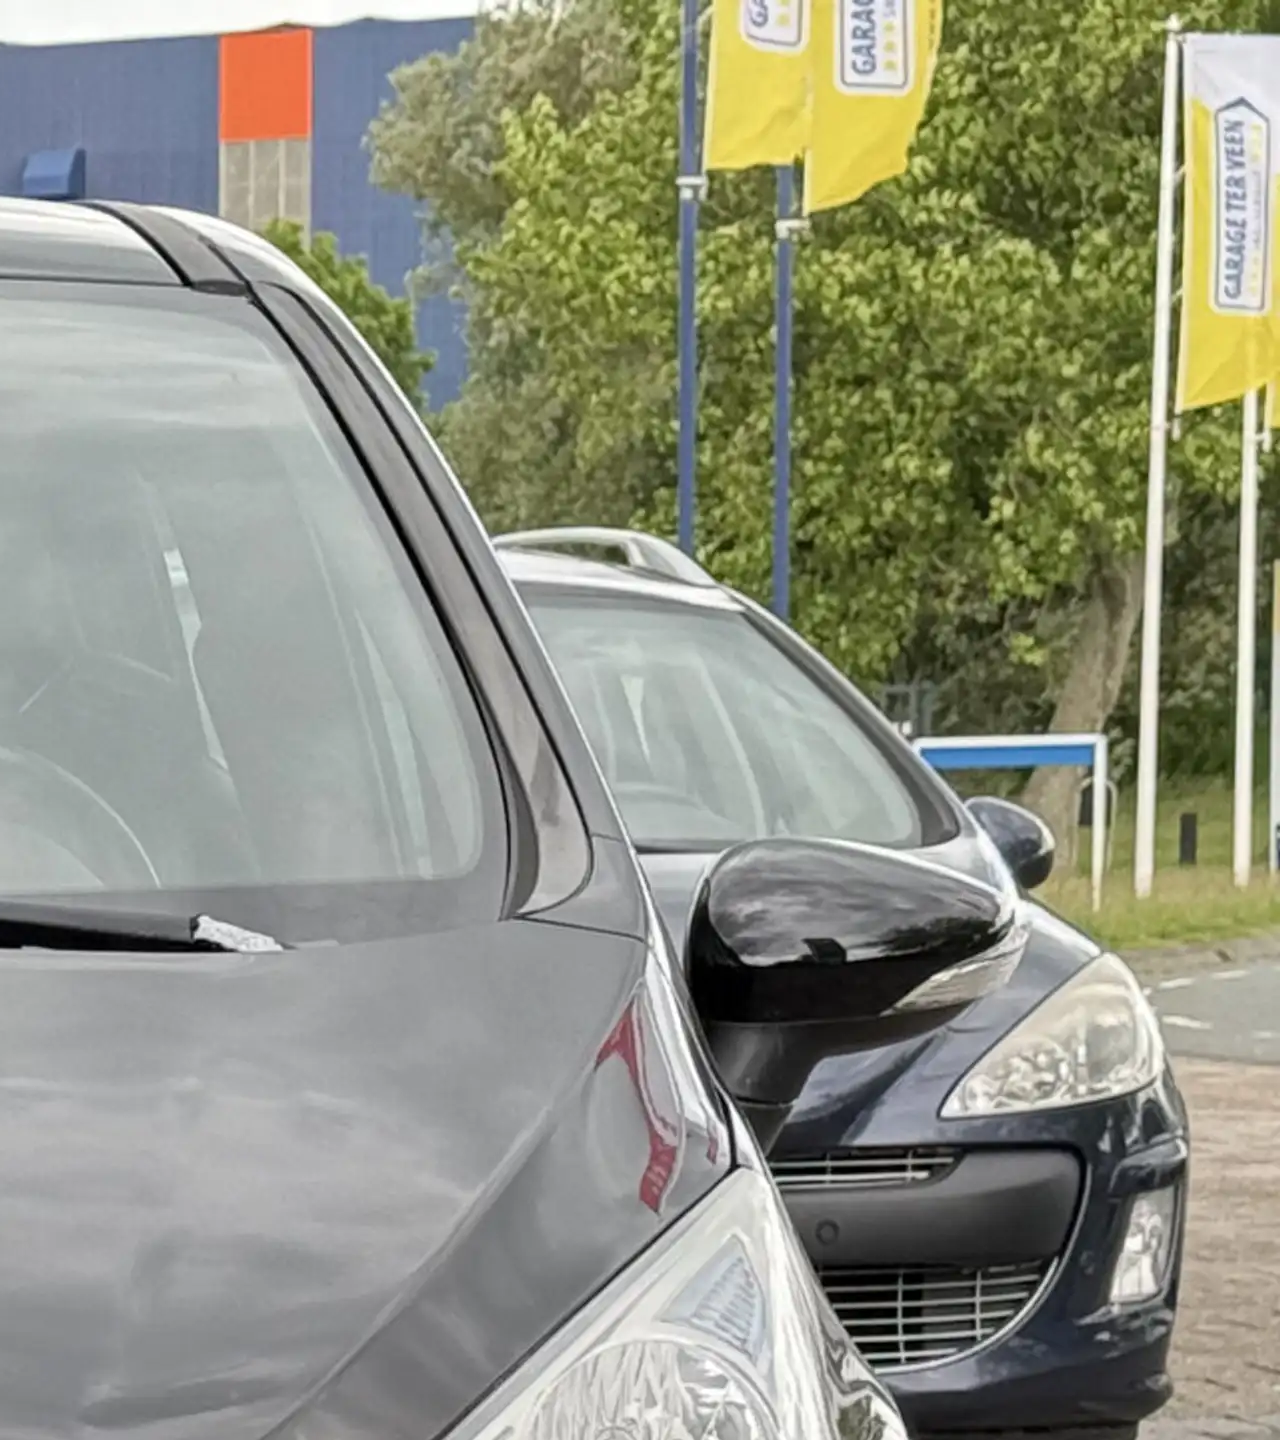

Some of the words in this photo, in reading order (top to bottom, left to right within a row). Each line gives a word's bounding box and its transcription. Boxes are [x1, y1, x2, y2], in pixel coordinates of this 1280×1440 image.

[1224, 119, 1246, 171] VEEN
[1225, 175, 1247, 212] TER
[1224, 218, 1247, 299] GARAGE
